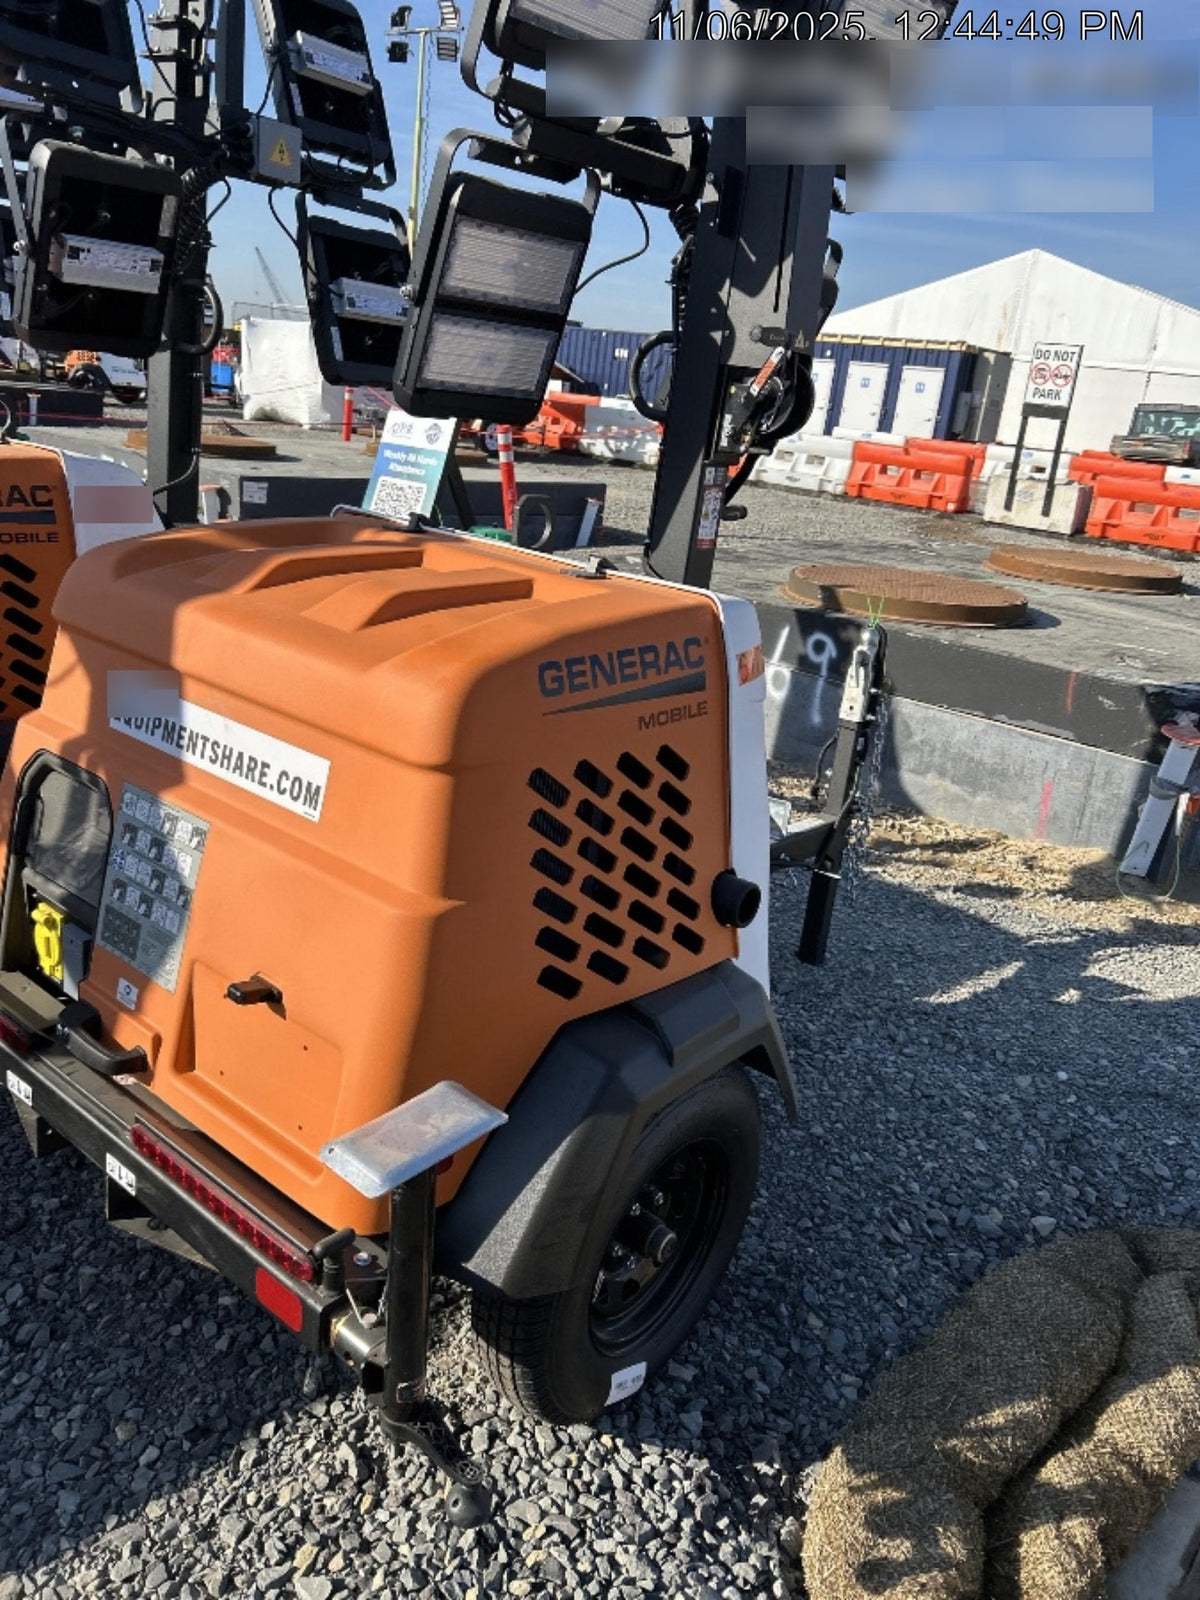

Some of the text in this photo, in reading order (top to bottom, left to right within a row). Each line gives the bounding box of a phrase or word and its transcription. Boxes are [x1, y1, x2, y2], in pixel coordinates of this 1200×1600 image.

[1035, 349, 1076, 362] DO NOT
[1033, 387, 1062, 400] PARK
[538, 636, 705, 698] GENERAC
[638, 700, 708, 731] MOBILE
[113, 717, 322, 812] QUIPMENTSHARE.COM
